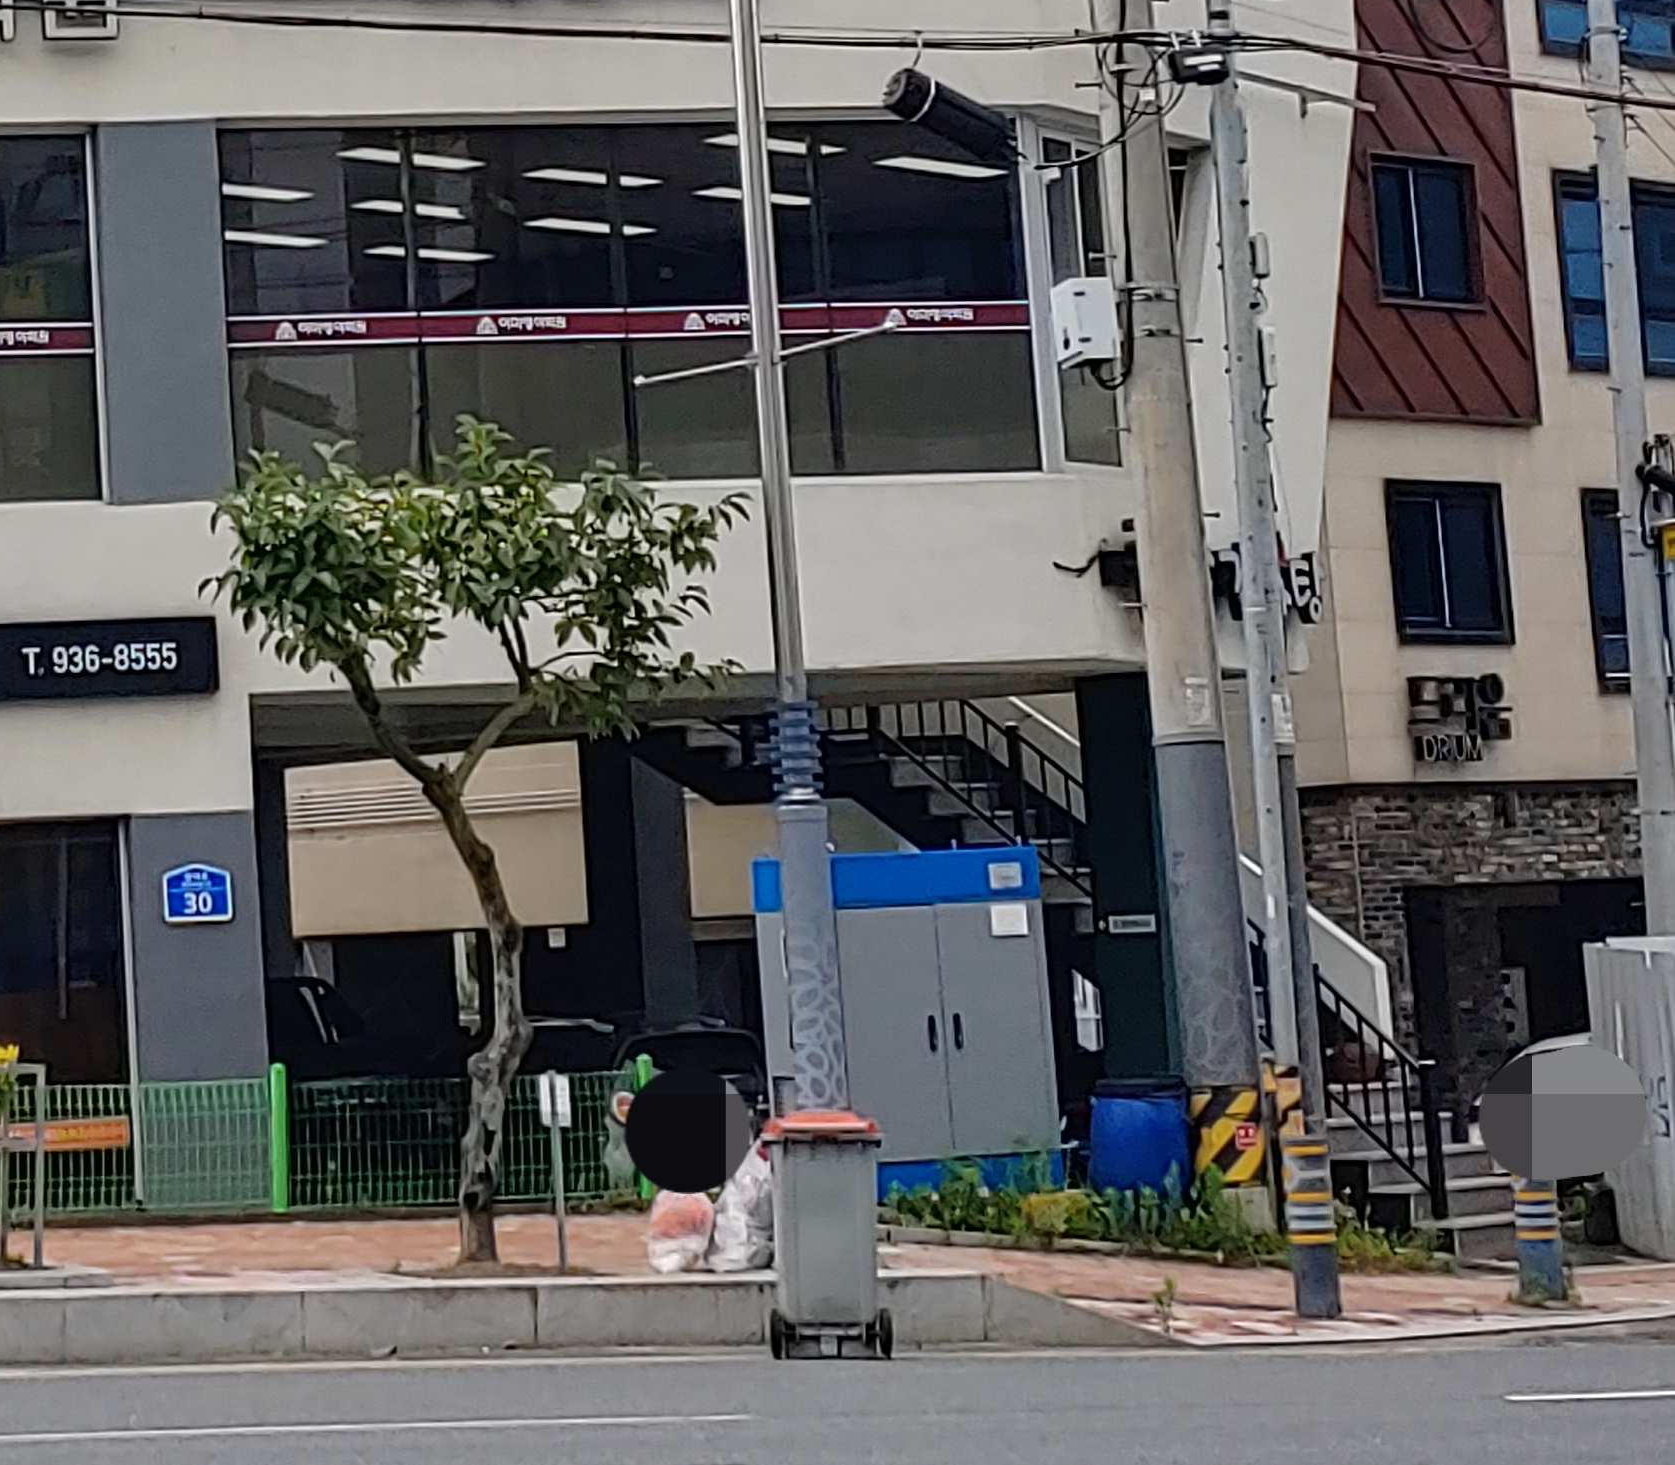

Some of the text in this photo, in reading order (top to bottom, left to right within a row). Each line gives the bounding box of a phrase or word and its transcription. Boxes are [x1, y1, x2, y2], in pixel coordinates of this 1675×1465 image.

[52, 641, 178, 675] 936-8555
[1423, 734, 1481, 762] DRUM
[183, 890, 212, 915] 30
